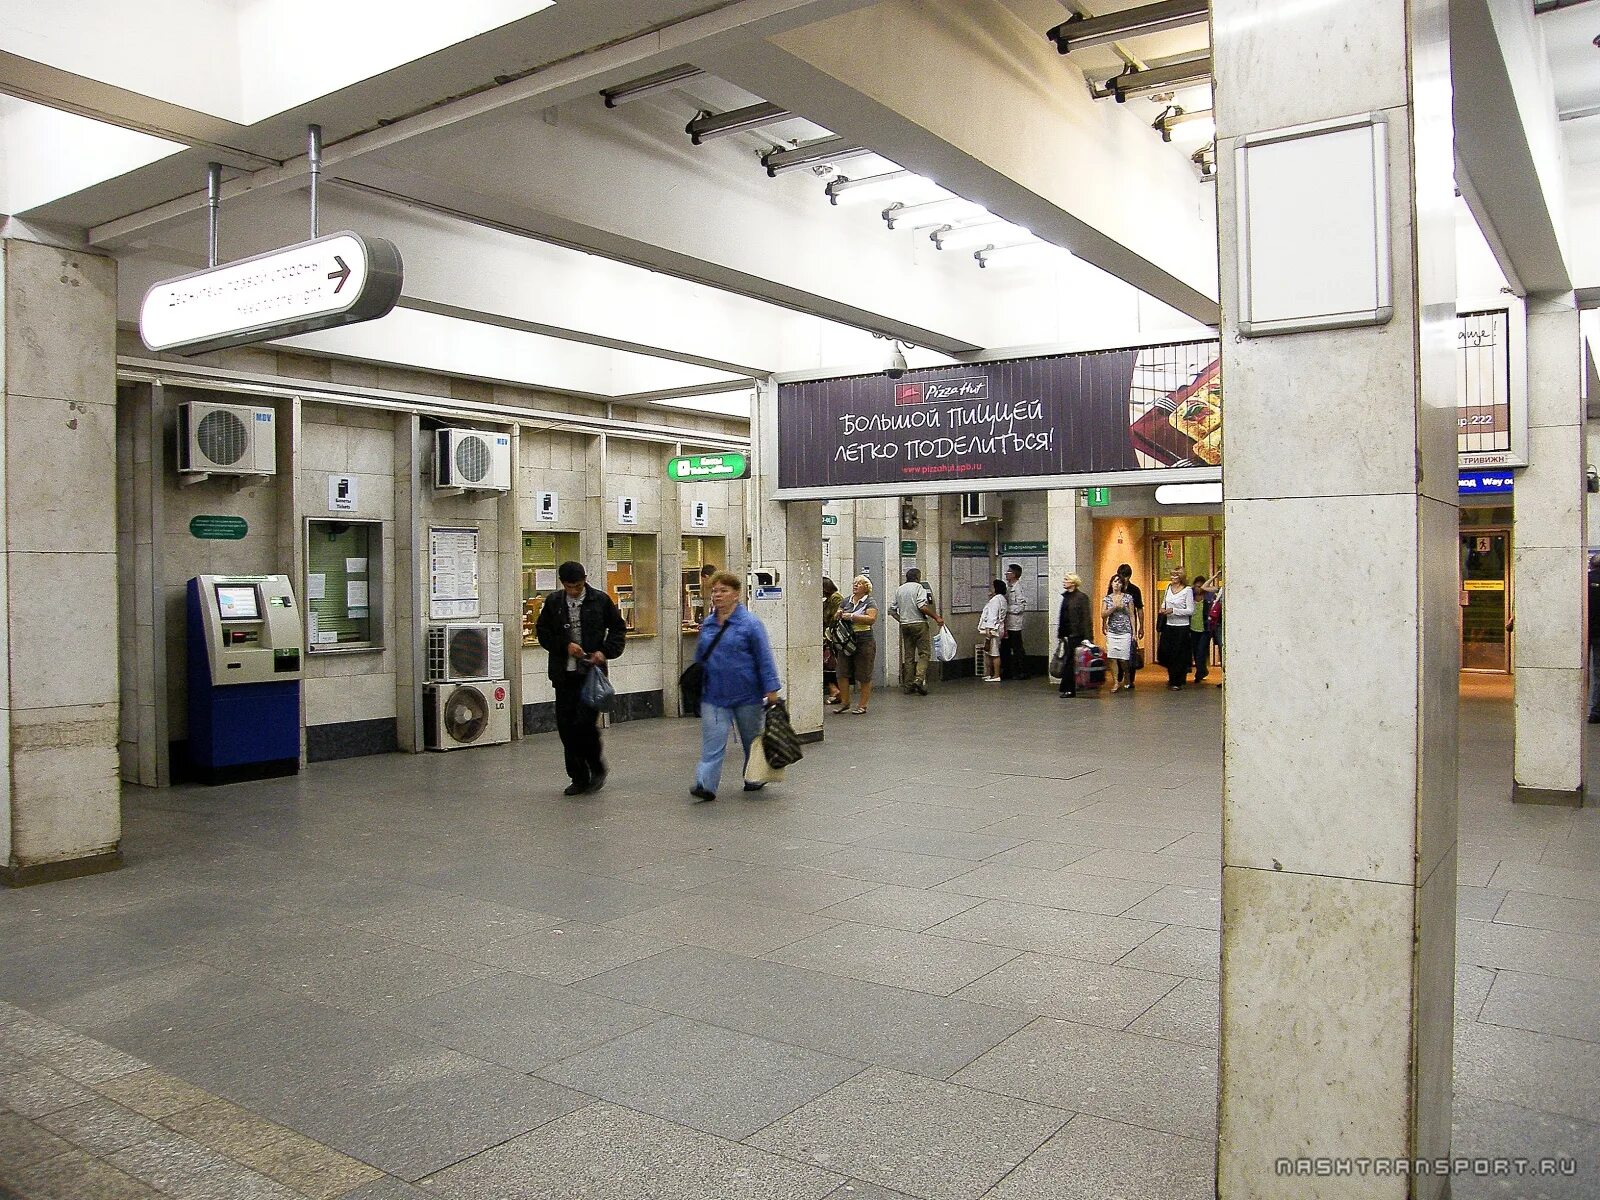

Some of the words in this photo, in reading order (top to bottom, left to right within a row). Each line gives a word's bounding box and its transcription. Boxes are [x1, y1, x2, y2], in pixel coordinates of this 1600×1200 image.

[925, 385, 959, 400] Pizza
[959, 382, 986, 396] Hut
[839, 408, 941, 436] БОЛЬШОЙ
[947, 399, 1043, 436] ПИЦЦЕЙ
[834, 442, 898, 464] ЛЕГКО
[904, 428, 1054, 460] ПОДЕЛИТЬСЯ!
[1463, 456, 1505, 464] ТРИВИЖН
[1458, 479, 1477, 488] ход
[1482, 477, 1503, 487] Way
[495, 702, 505, 710] LG
